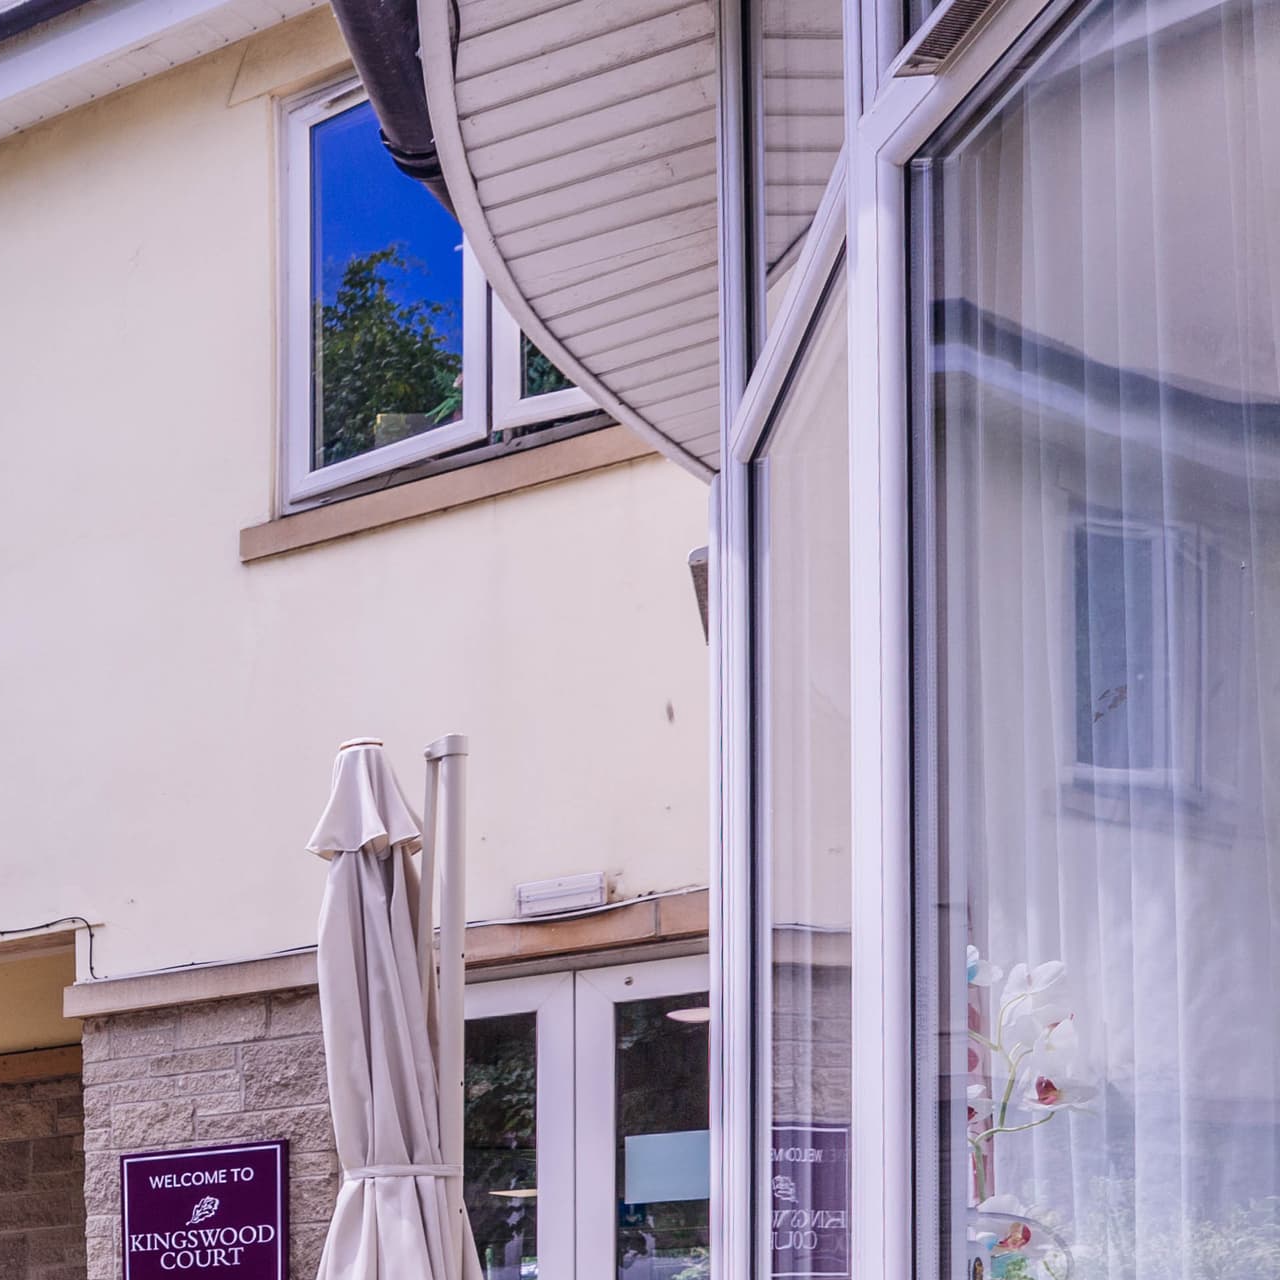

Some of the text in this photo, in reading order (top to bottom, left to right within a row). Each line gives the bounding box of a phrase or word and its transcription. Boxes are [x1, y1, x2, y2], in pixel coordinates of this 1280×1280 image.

[149, 1167, 255, 1190] WELCOME TO
[129, 1225, 275, 1252] KINGSWOOD
[160, 1247, 245, 1270] COURT
